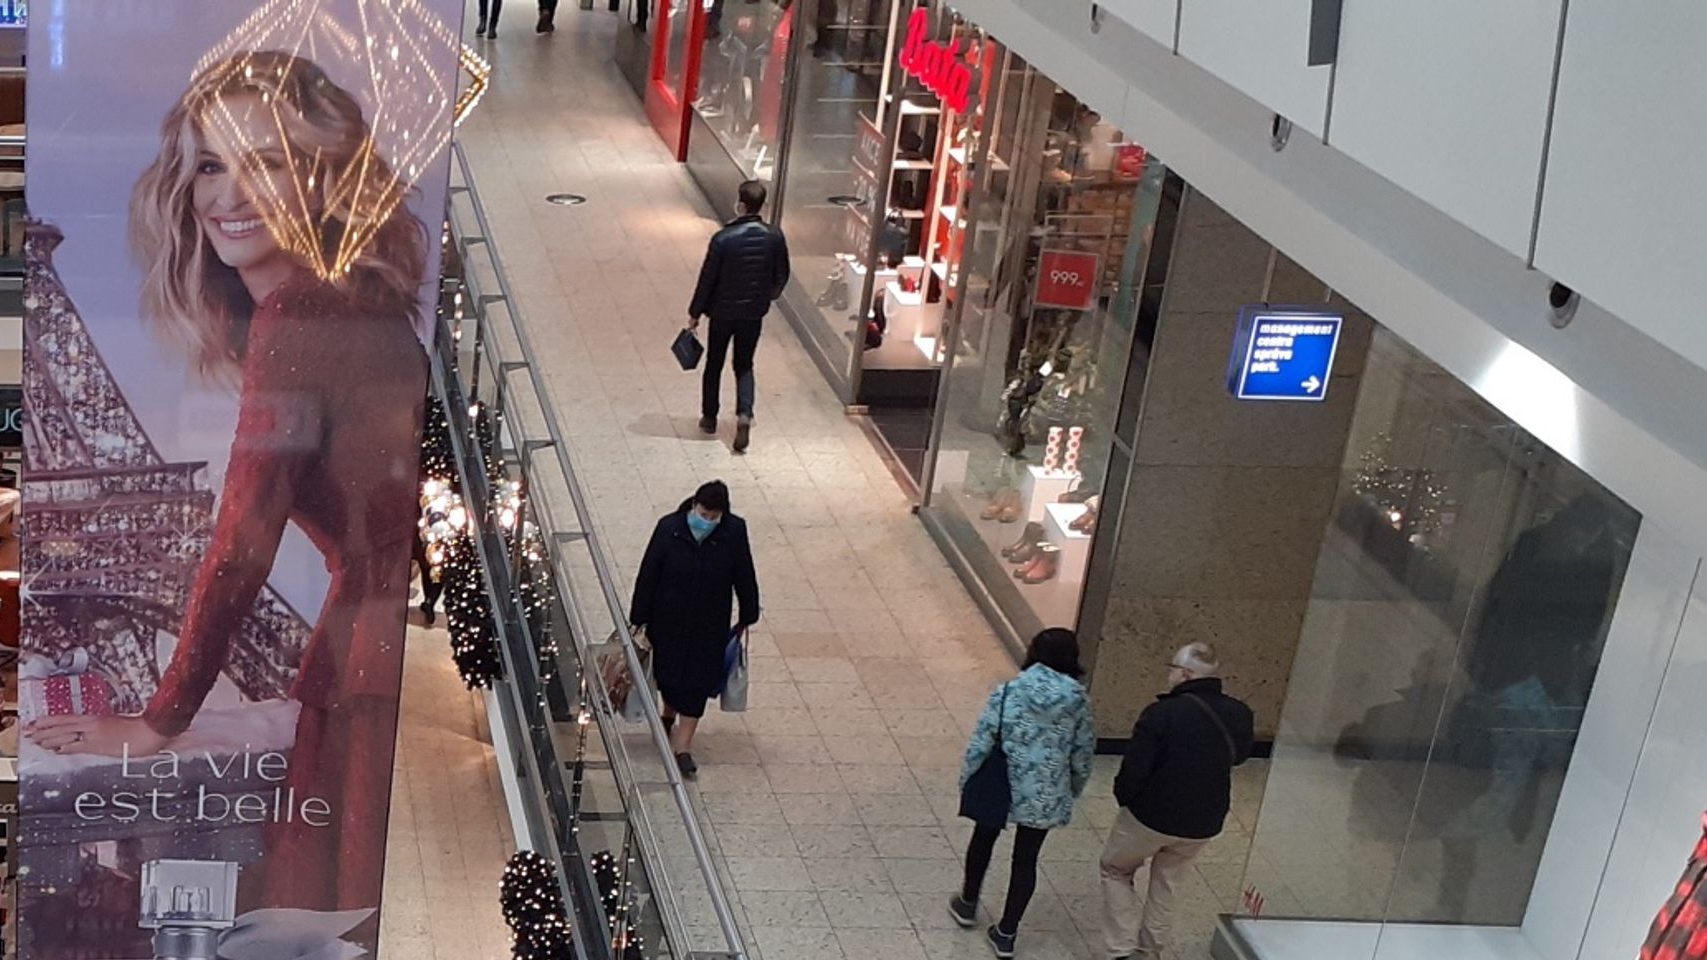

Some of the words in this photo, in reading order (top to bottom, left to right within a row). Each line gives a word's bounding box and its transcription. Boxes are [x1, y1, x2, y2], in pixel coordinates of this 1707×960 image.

[1050, 269, 1079, 287] 999
[121, 742, 179, 780] La
[204, 743, 289, 782] vie
[74, 786, 177, 822] est
[196, 784, 331, 828] belle
